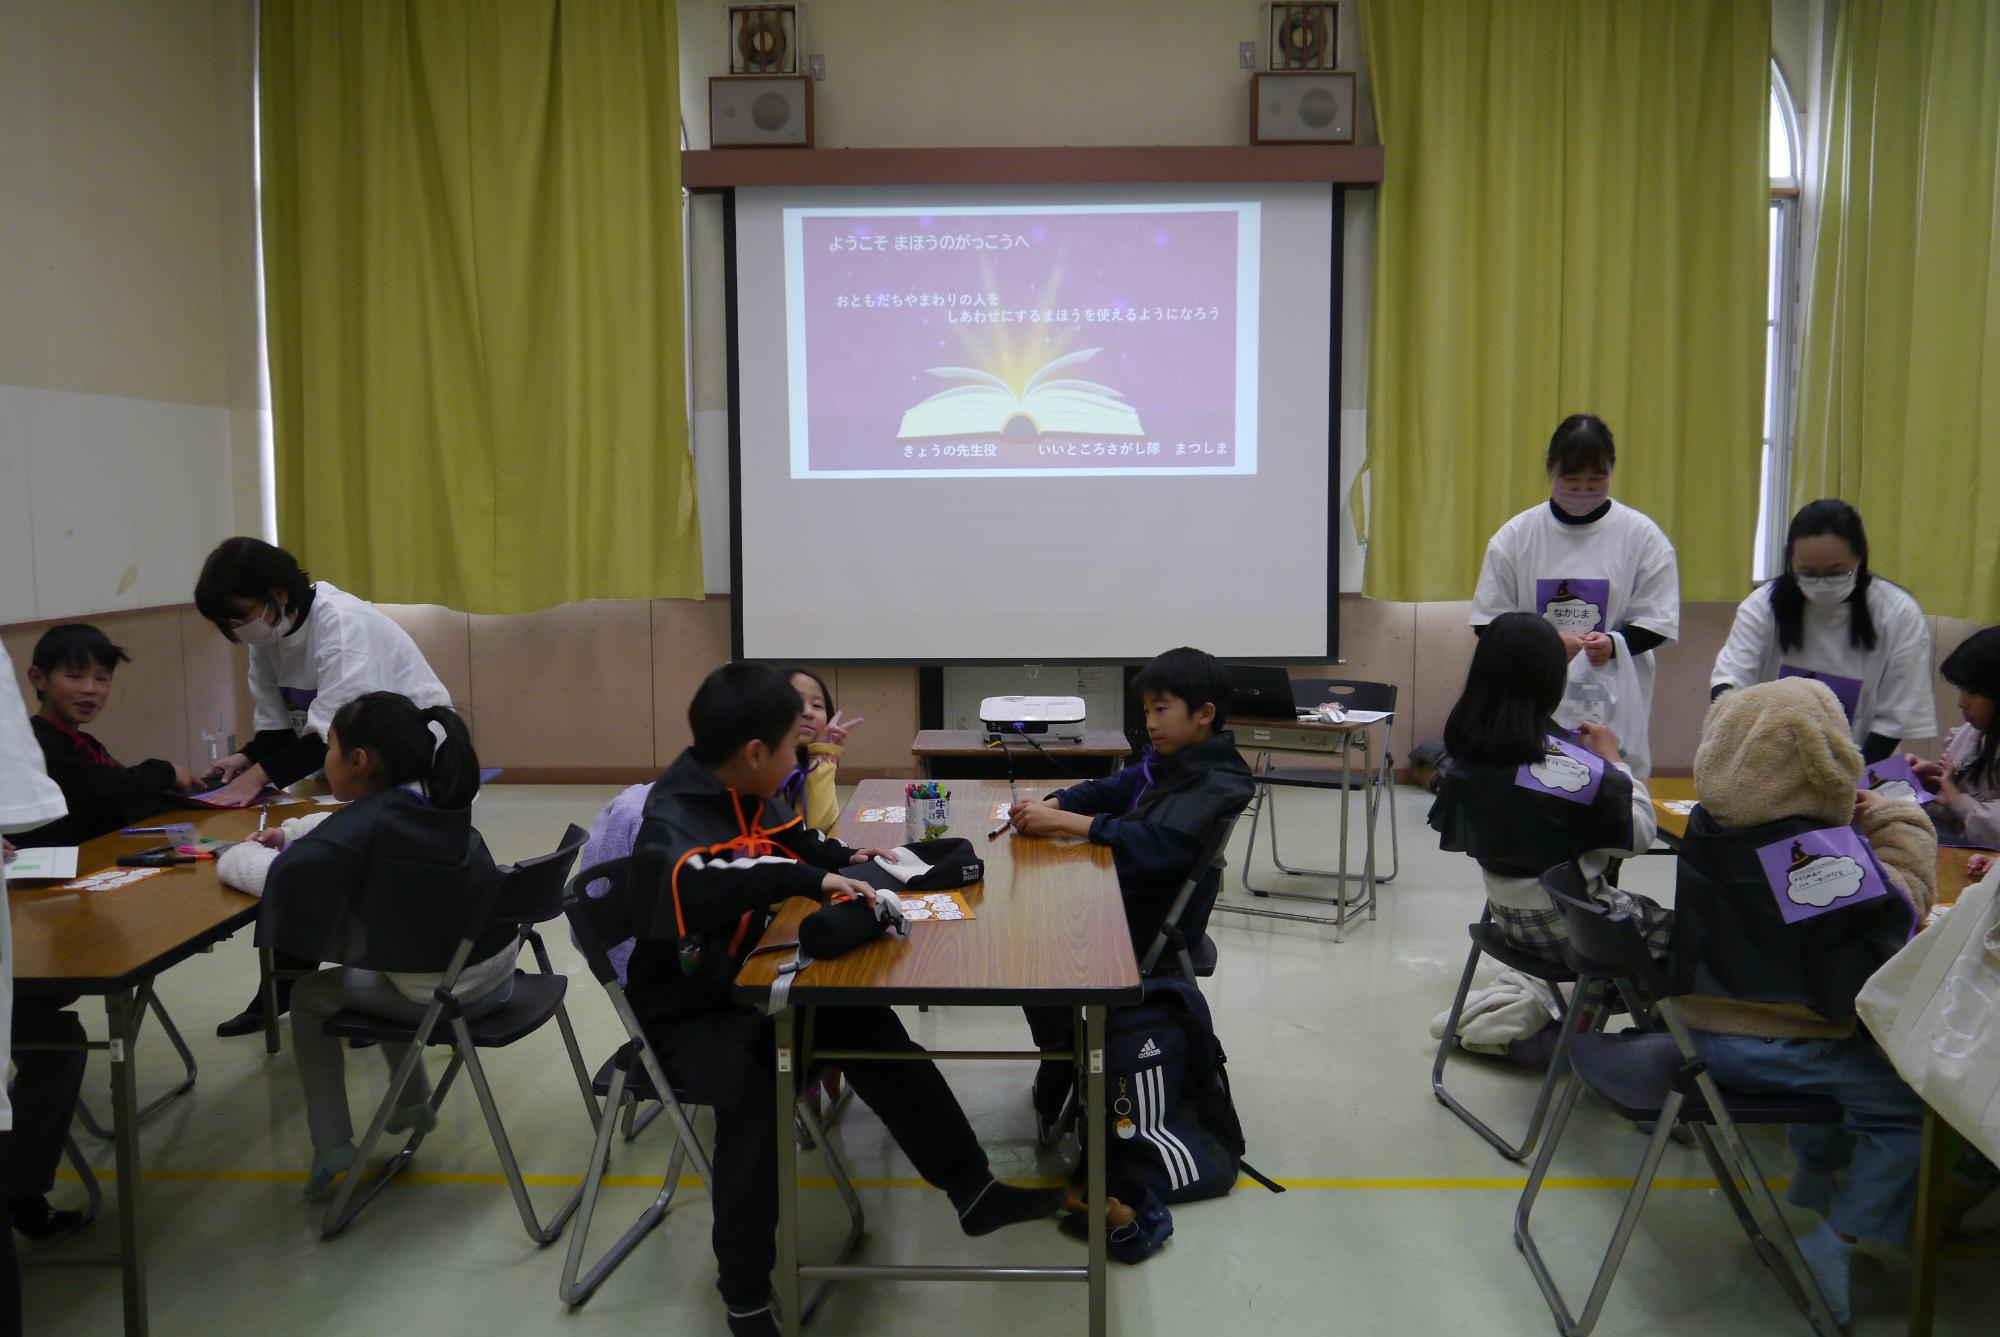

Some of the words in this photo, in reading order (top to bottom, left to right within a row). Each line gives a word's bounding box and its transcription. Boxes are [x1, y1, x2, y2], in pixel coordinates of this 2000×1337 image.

[829, 235, 887, 251] ようこそ
[894, 233, 1030, 251] まほうのがっこうへ
[836, 293, 1000, 308] おともだちやまわりの人を
[947, 306, 1220, 324] しあわせにするまほうを使えるようになろう
[903, 444, 998, 459] きょうの先生役
[1038, 442, 1161, 457] いいところさがし隊
[1175, 440, 1228, 455] まつしま
[1555, 608, 1590, 618] なかじま
[936, 799, 946, 819] 牛乳
[1138, 1049, 1161, 1058] adidas
